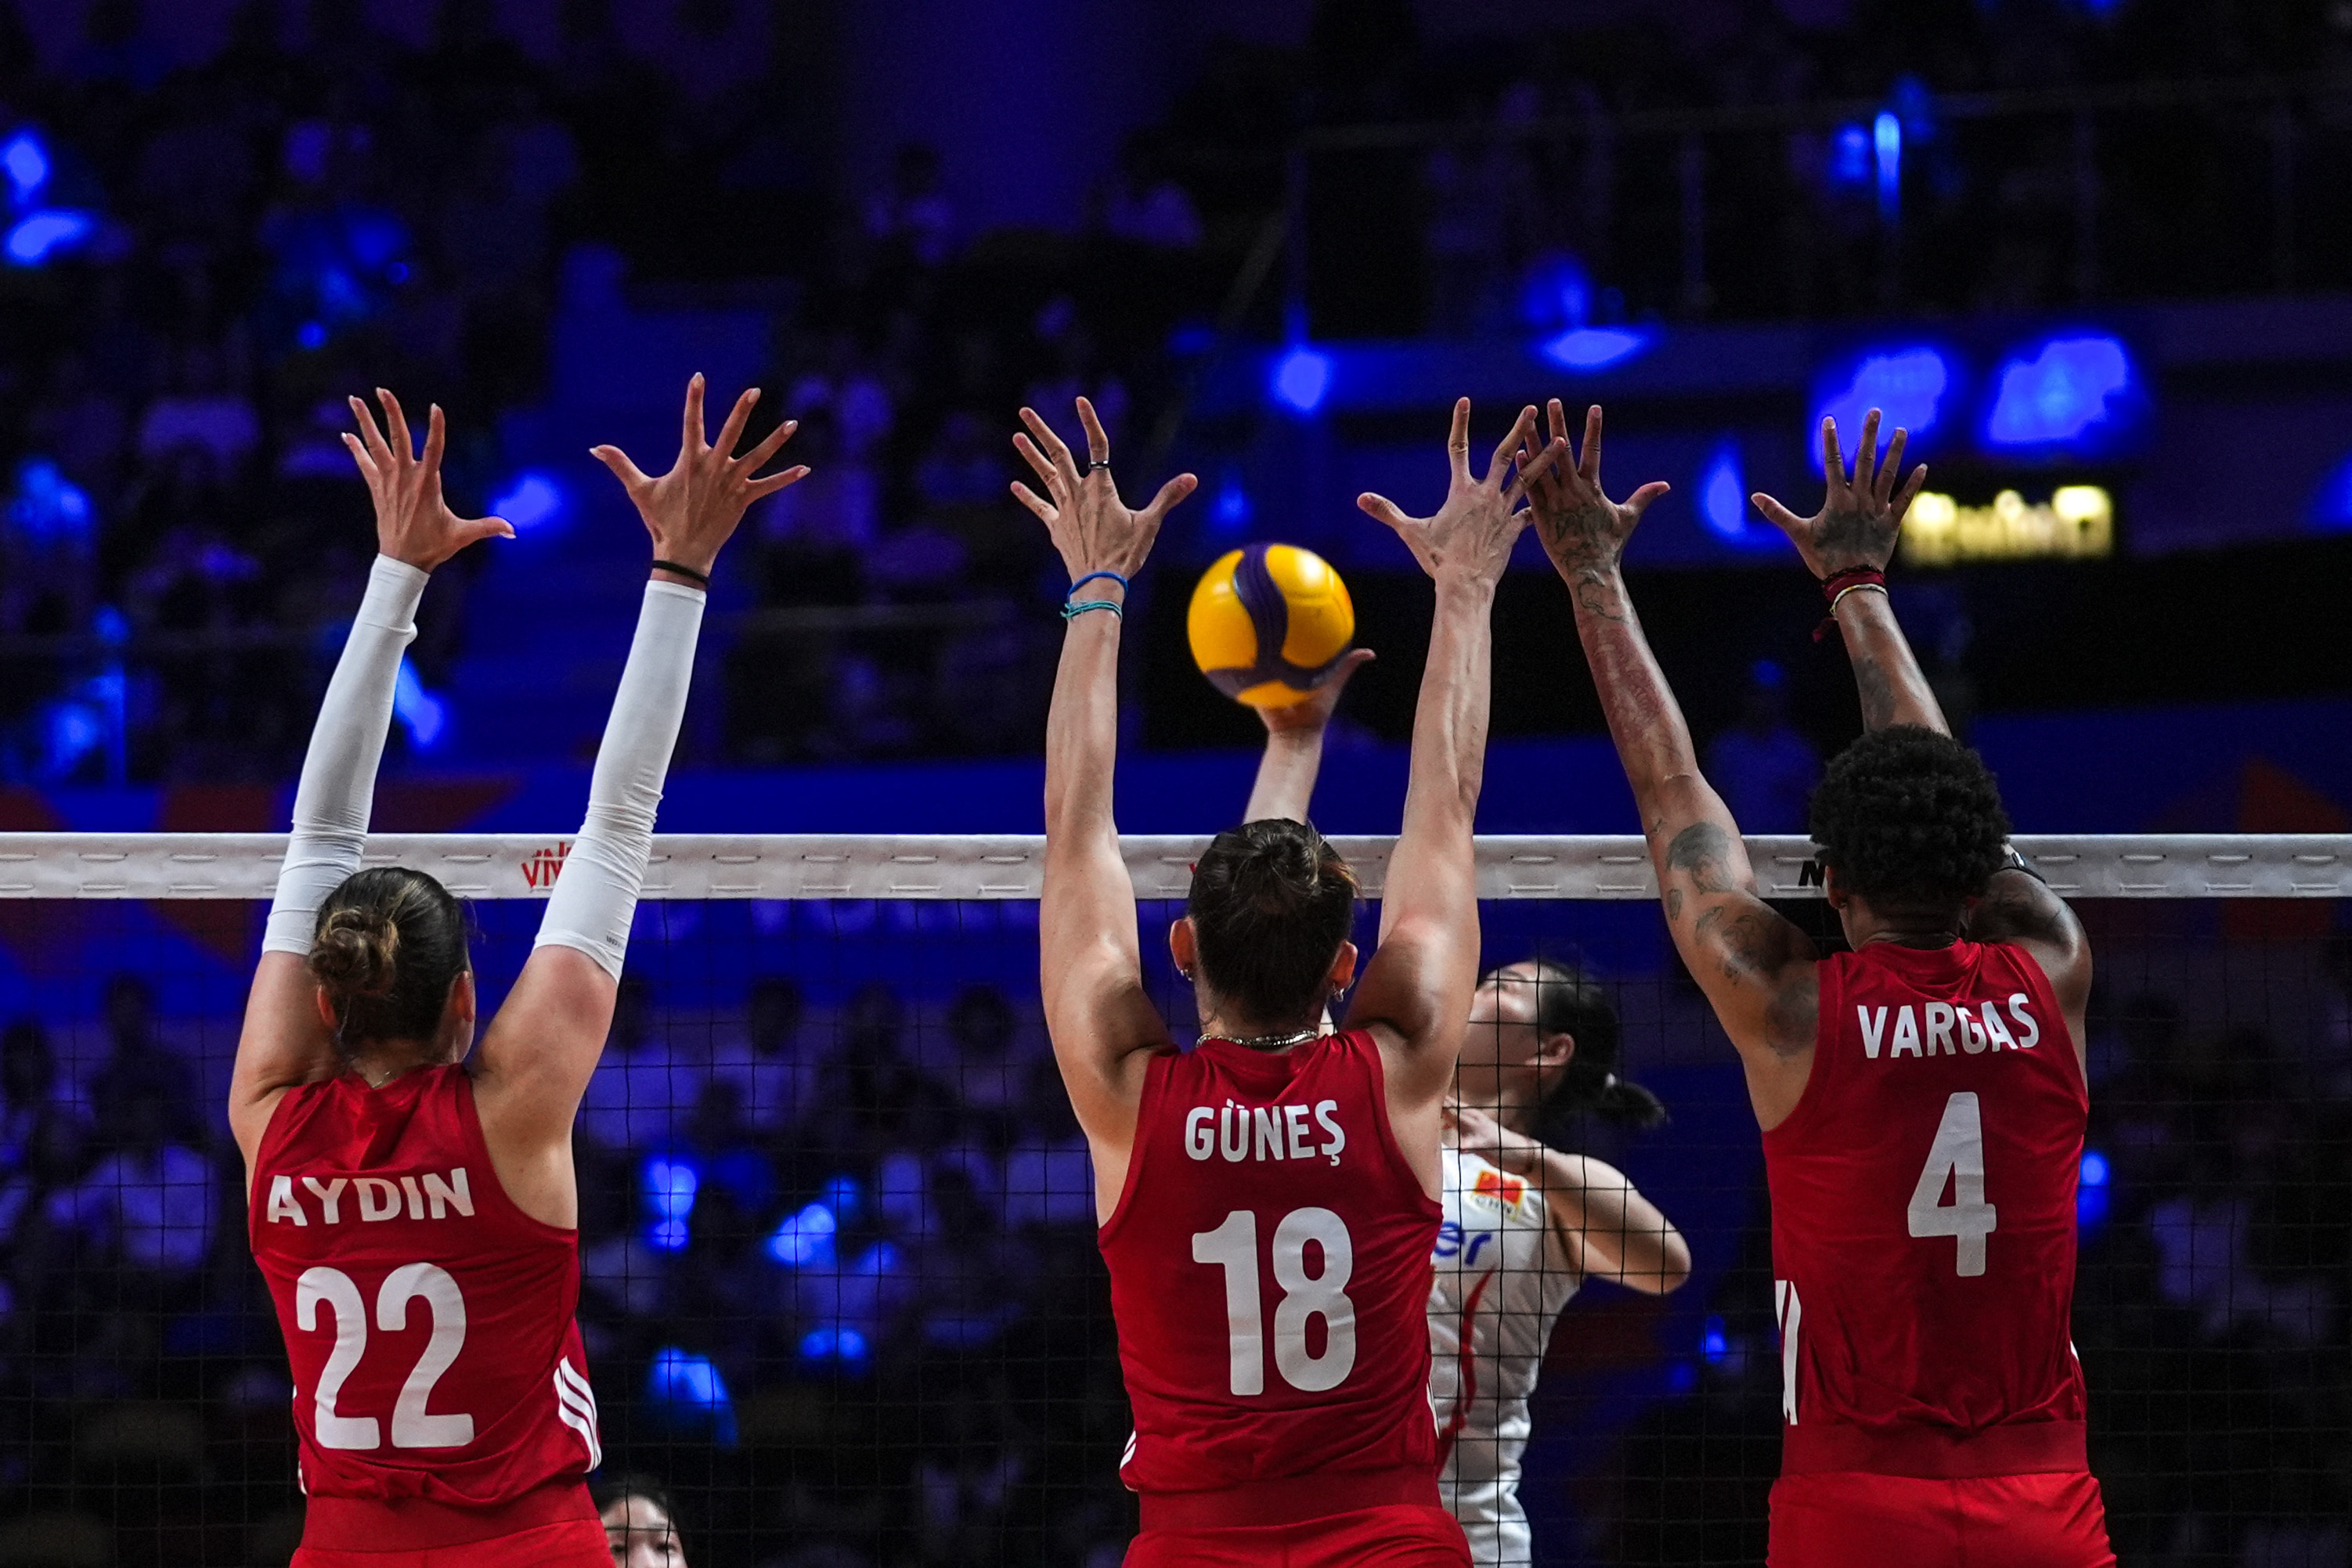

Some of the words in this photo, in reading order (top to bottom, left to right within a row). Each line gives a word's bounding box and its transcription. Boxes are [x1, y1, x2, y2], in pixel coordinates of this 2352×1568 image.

[1857, 993, 2039, 1058] VARGAS
[1185, 1098, 1345, 1166] GÜNEŞ
[1907, 1091, 1997, 1277] 4
[267, 1167, 474, 1227] AYDIN
[296, 1262, 474, 1450] 22
[1192, 1206, 1357, 1396] 18
